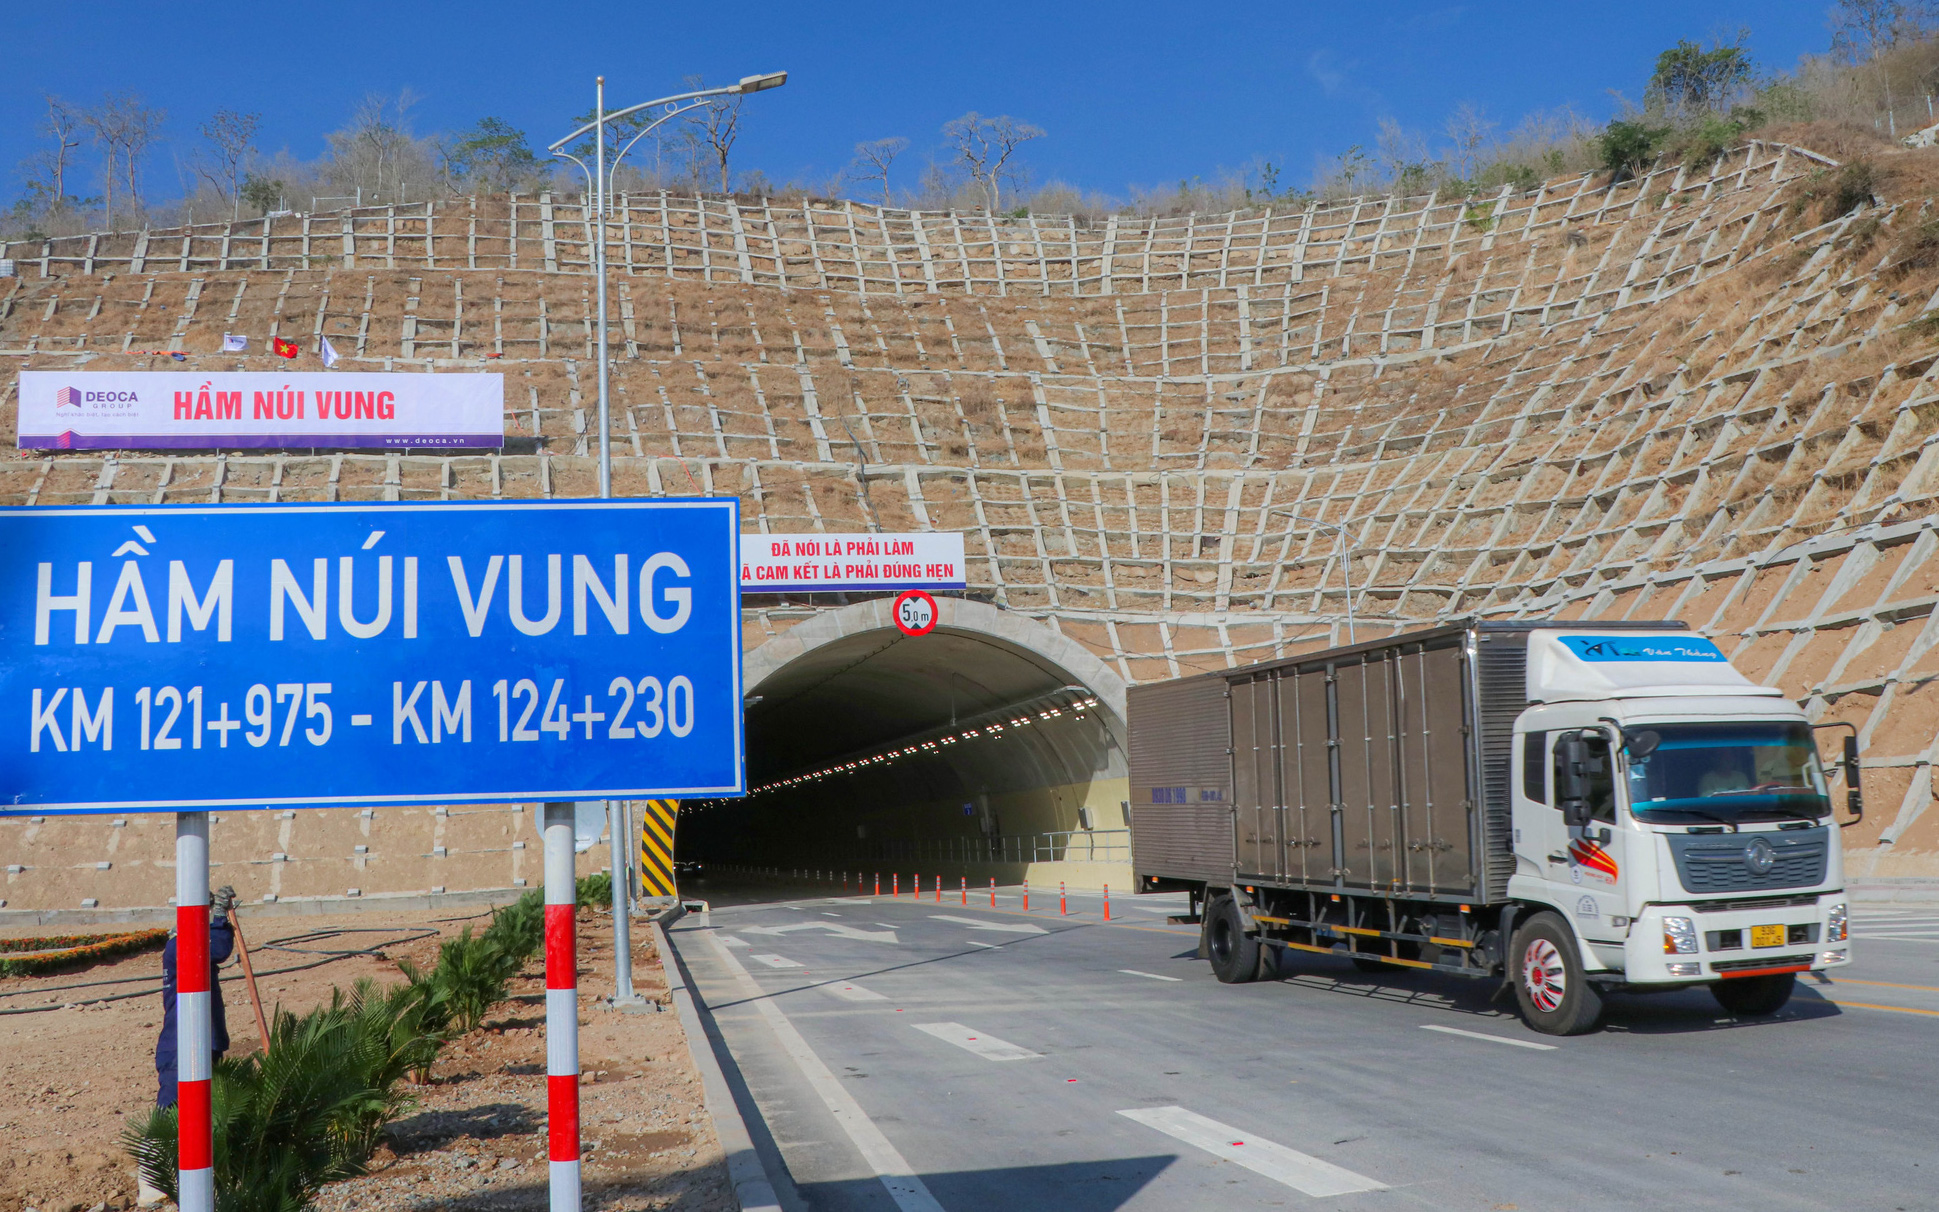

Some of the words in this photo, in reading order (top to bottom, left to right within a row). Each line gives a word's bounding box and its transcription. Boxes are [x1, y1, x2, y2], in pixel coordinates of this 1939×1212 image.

[86, 391, 138, 402] DEOCA
[174, 381, 242, 420] HẦM
[253, 385, 305, 420] NÚI
[315, 391, 395, 420] VUNG
[771, 539, 791, 557] ĐÃ
[796, 539, 820, 557] NÓI
[825, 538, 842, 556] LÀ
[847, 537, 880, 556] PHẢI
[884, 538, 914, 556] LÀM
[741, 563, 751, 581] Ã
[756, 565, 788, 581] CAM
[793, 560, 820, 580] KẾT
[824, 560, 842, 579] LÀ
[845, 560, 879, 579] PHẢI
[882, 561, 922, 579] ĐÚNG
[926, 563, 954, 581] HẸN
[34, 525, 234, 646] HẦM
[269, 531, 418, 641] NÚI
[447, 552, 692, 638] VUNG
[920, 613, 930, 622] m
[30, 687, 113, 753] KM
[135, 683, 333, 751] 121+975
[352, 714, 372, 726] -
[393, 680, 472, 745] KM
[493, 675, 694, 742] 124+230
